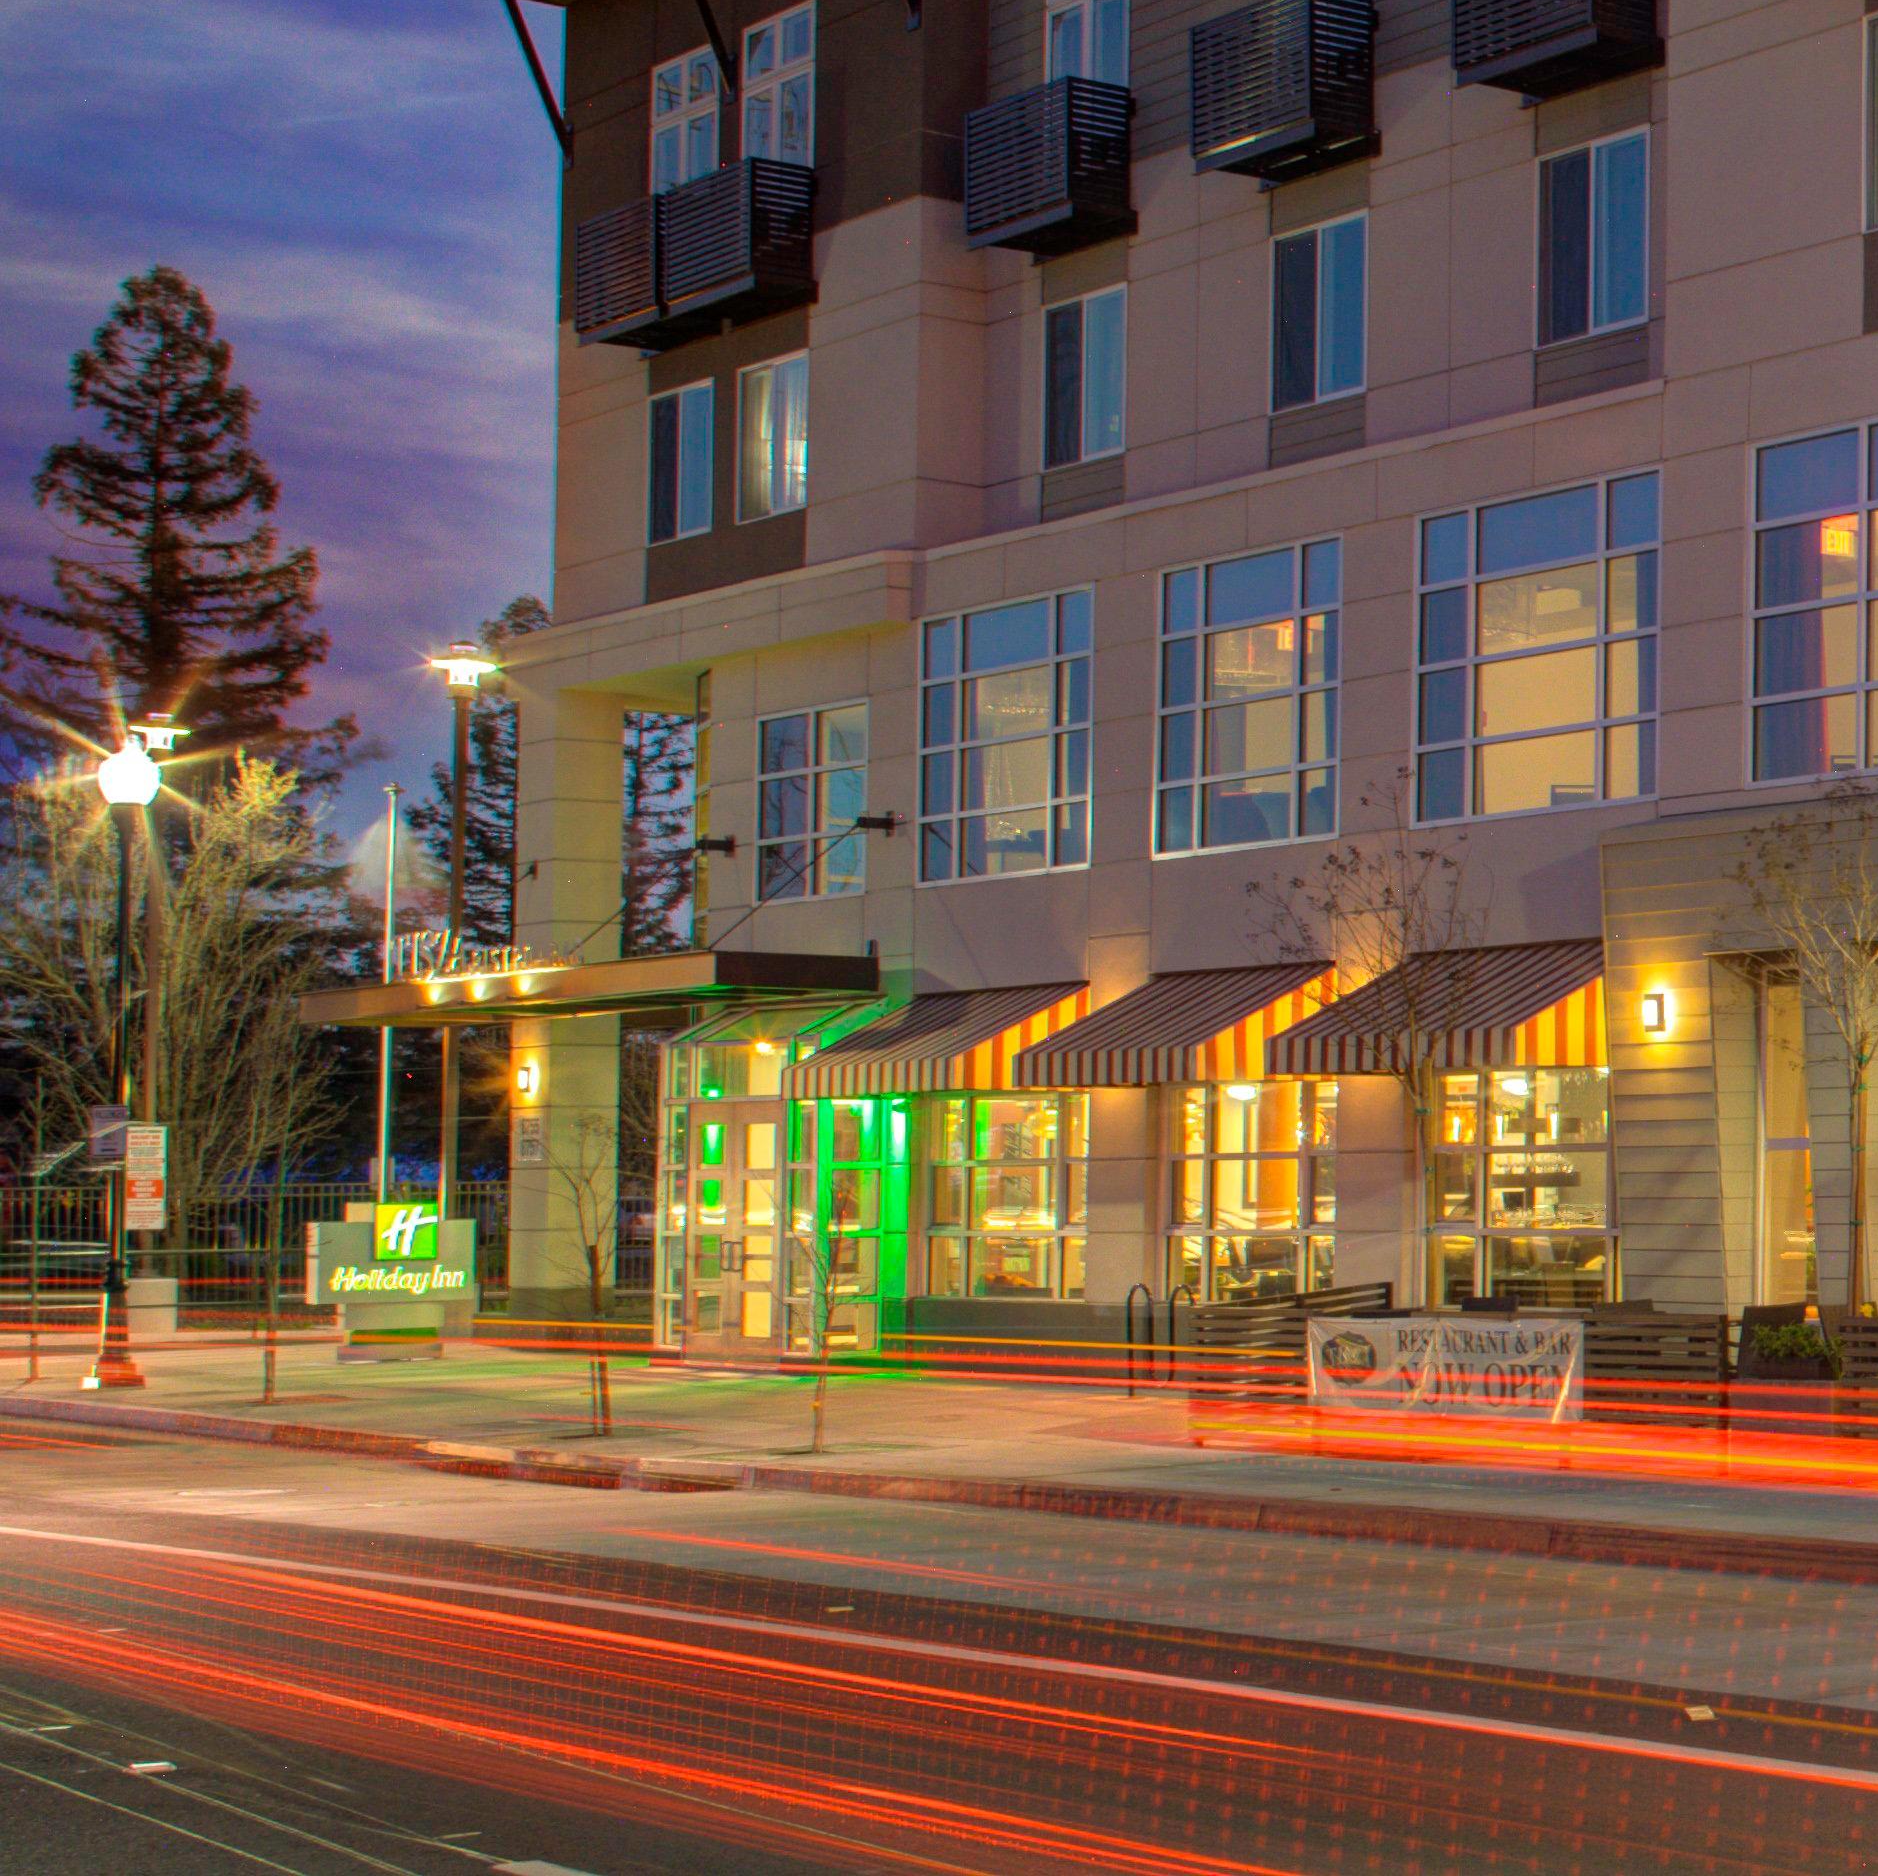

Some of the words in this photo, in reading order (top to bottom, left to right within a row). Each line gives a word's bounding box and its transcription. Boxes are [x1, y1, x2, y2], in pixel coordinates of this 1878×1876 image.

[330, 1265, 430, 1295] Holiday
[431, 1264, 466, 1289] Inn
[1397, 1328, 1509, 1355] RESTAURANT
[1515, 1330, 1529, 1355] &
[1533, 1330, 1572, 1356] BAR
[1397, 1361, 1474, 1405] NOW
[1482, 1362, 1572, 1409] OPEN
